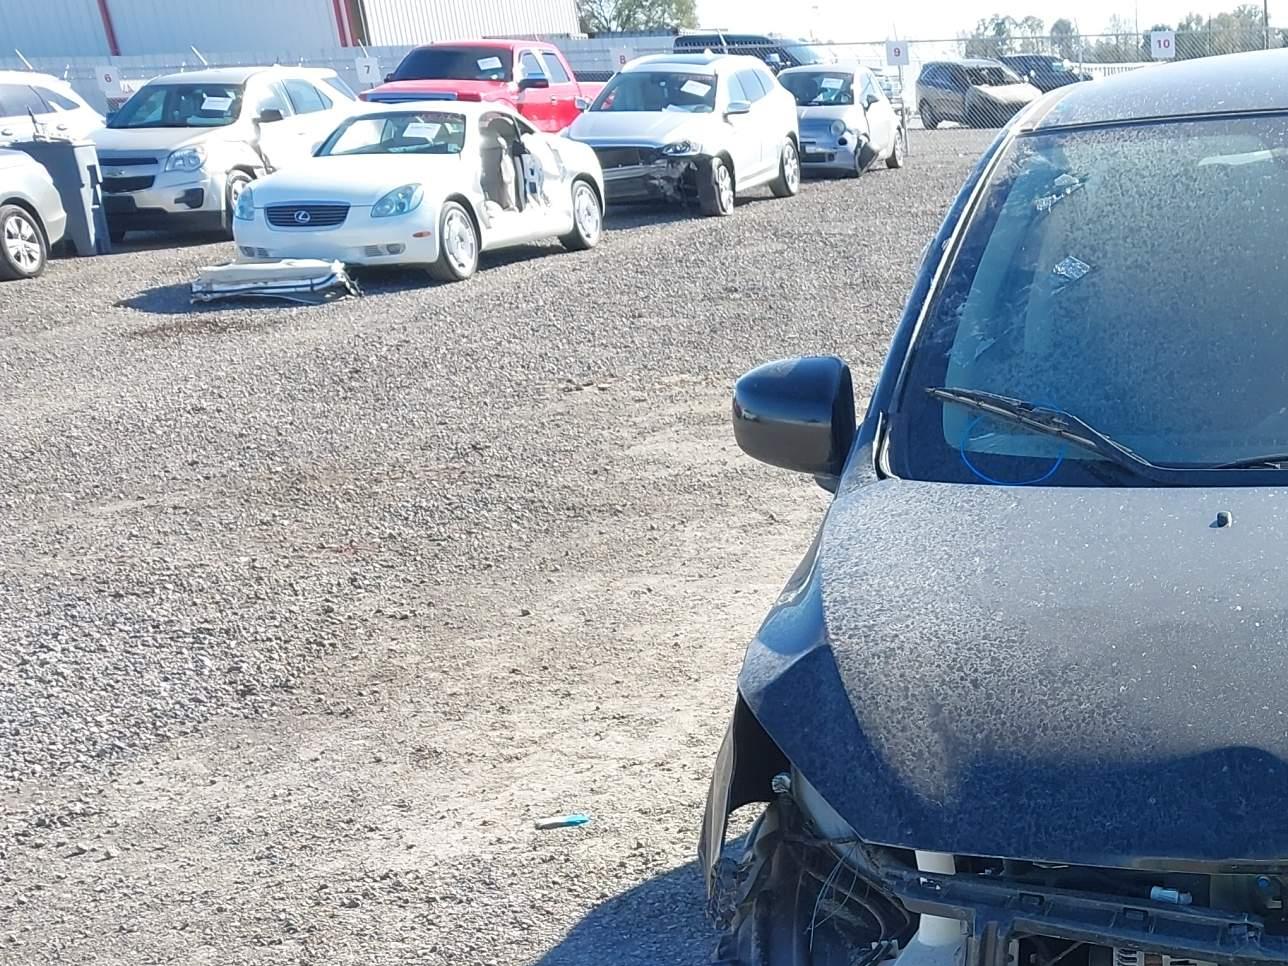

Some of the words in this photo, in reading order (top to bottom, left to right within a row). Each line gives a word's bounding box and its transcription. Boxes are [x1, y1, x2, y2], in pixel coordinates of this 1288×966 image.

[1156, 39, 1170, 49] 10
[893, 47, 901, 57] 9
[364, 65, 371, 75] 7
[104, 73, 112, 83] 6
